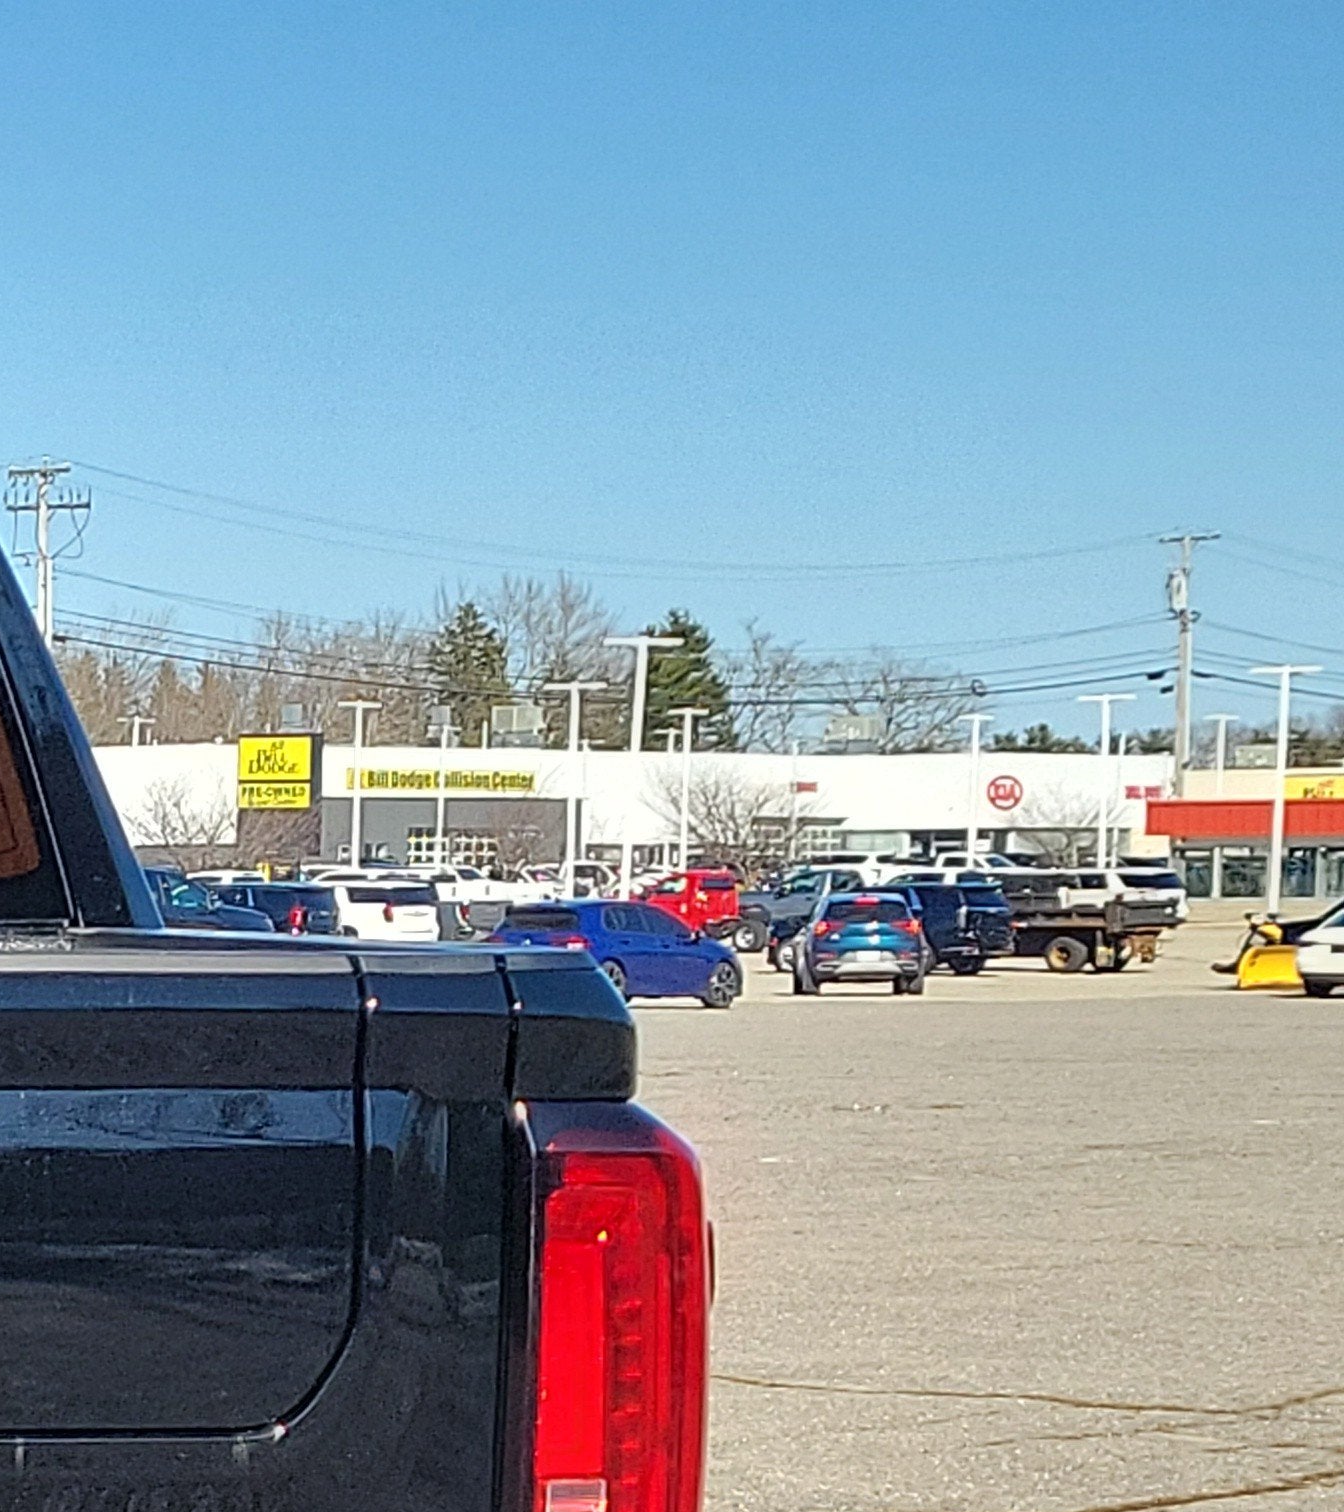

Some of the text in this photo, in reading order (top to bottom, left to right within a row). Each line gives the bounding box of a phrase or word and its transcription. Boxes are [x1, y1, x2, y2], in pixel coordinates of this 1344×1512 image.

[367, 770, 389, 788] Bill
[391, 769, 433, 790] Dodge
[492, 770, 535, 789] Center
